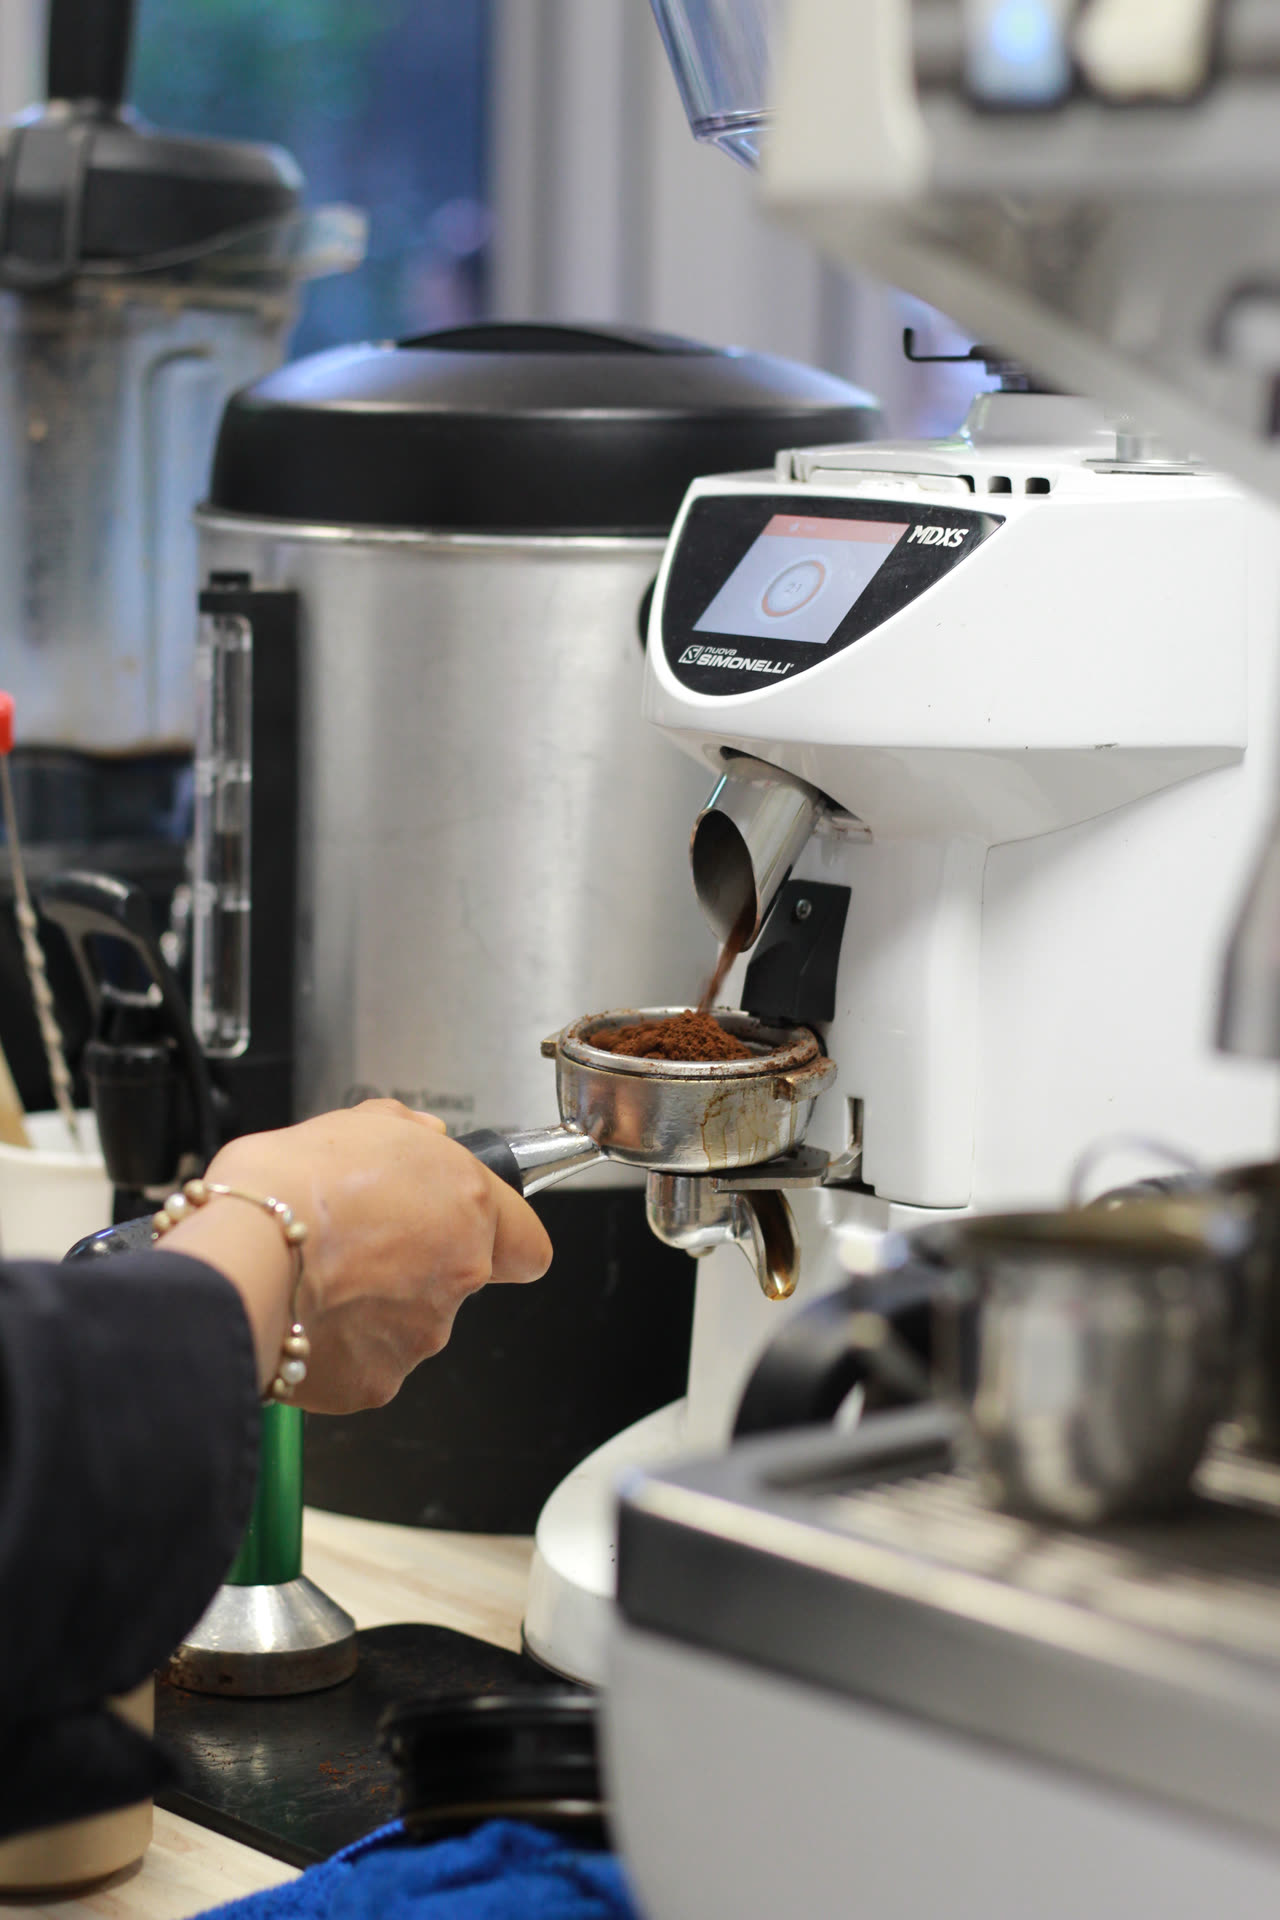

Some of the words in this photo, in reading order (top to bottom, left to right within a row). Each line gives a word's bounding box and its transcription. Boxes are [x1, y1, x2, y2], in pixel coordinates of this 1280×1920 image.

[906, 525, 969, 548] MDXS
[704, 646, 738, 656] nuova
[696, 653, 791, 675] SIMONELLI
